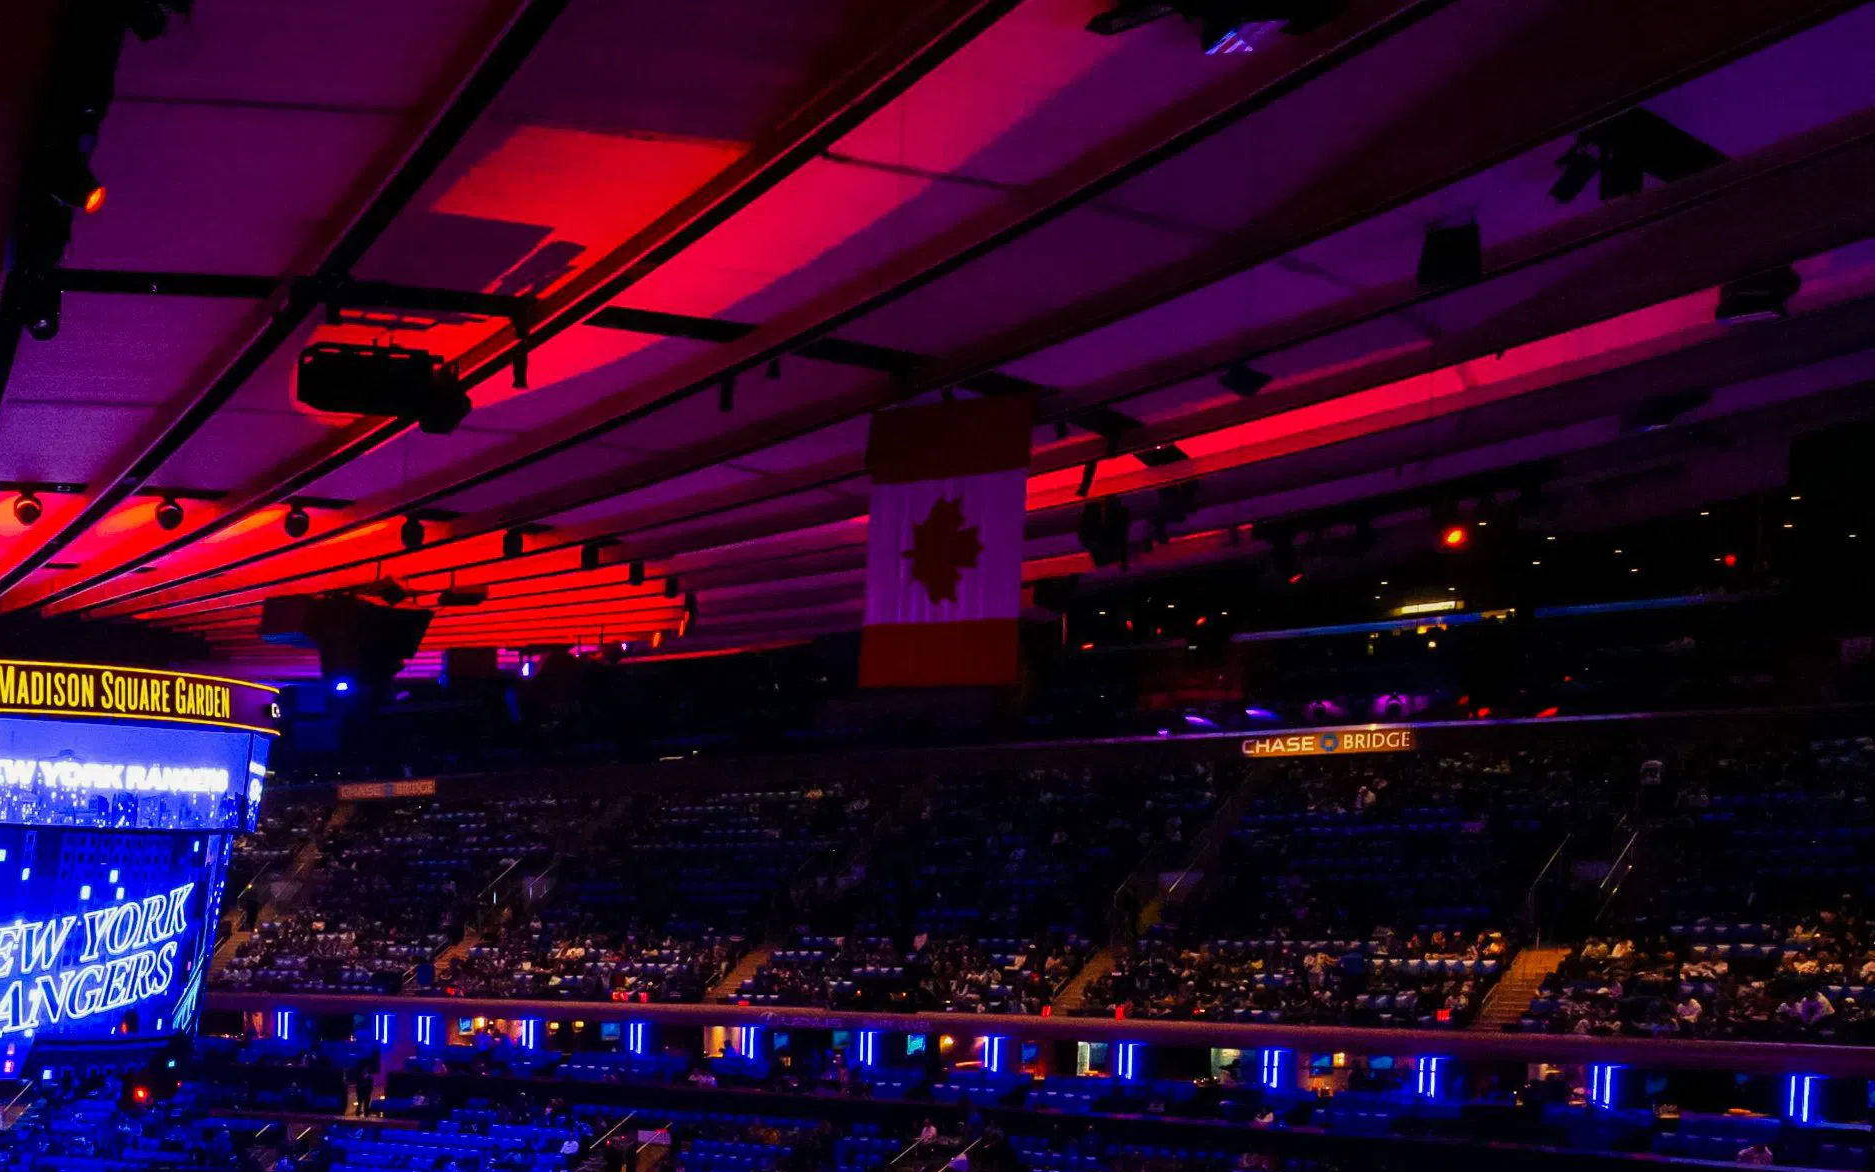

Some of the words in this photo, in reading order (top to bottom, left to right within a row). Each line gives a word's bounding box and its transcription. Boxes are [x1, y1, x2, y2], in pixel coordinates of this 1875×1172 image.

[100, 671, 171, 713] SQUARE
[175, 677, 230, 719] GARDEN
[1241, 735, 1316, 754] CHASE
[1343, 731, 1411, 750] BRIDGE
[39, 761, 124, 790] YORK
[126, 765, 229, 793] RANGERS
[80, 883, 195, 962] YORK
